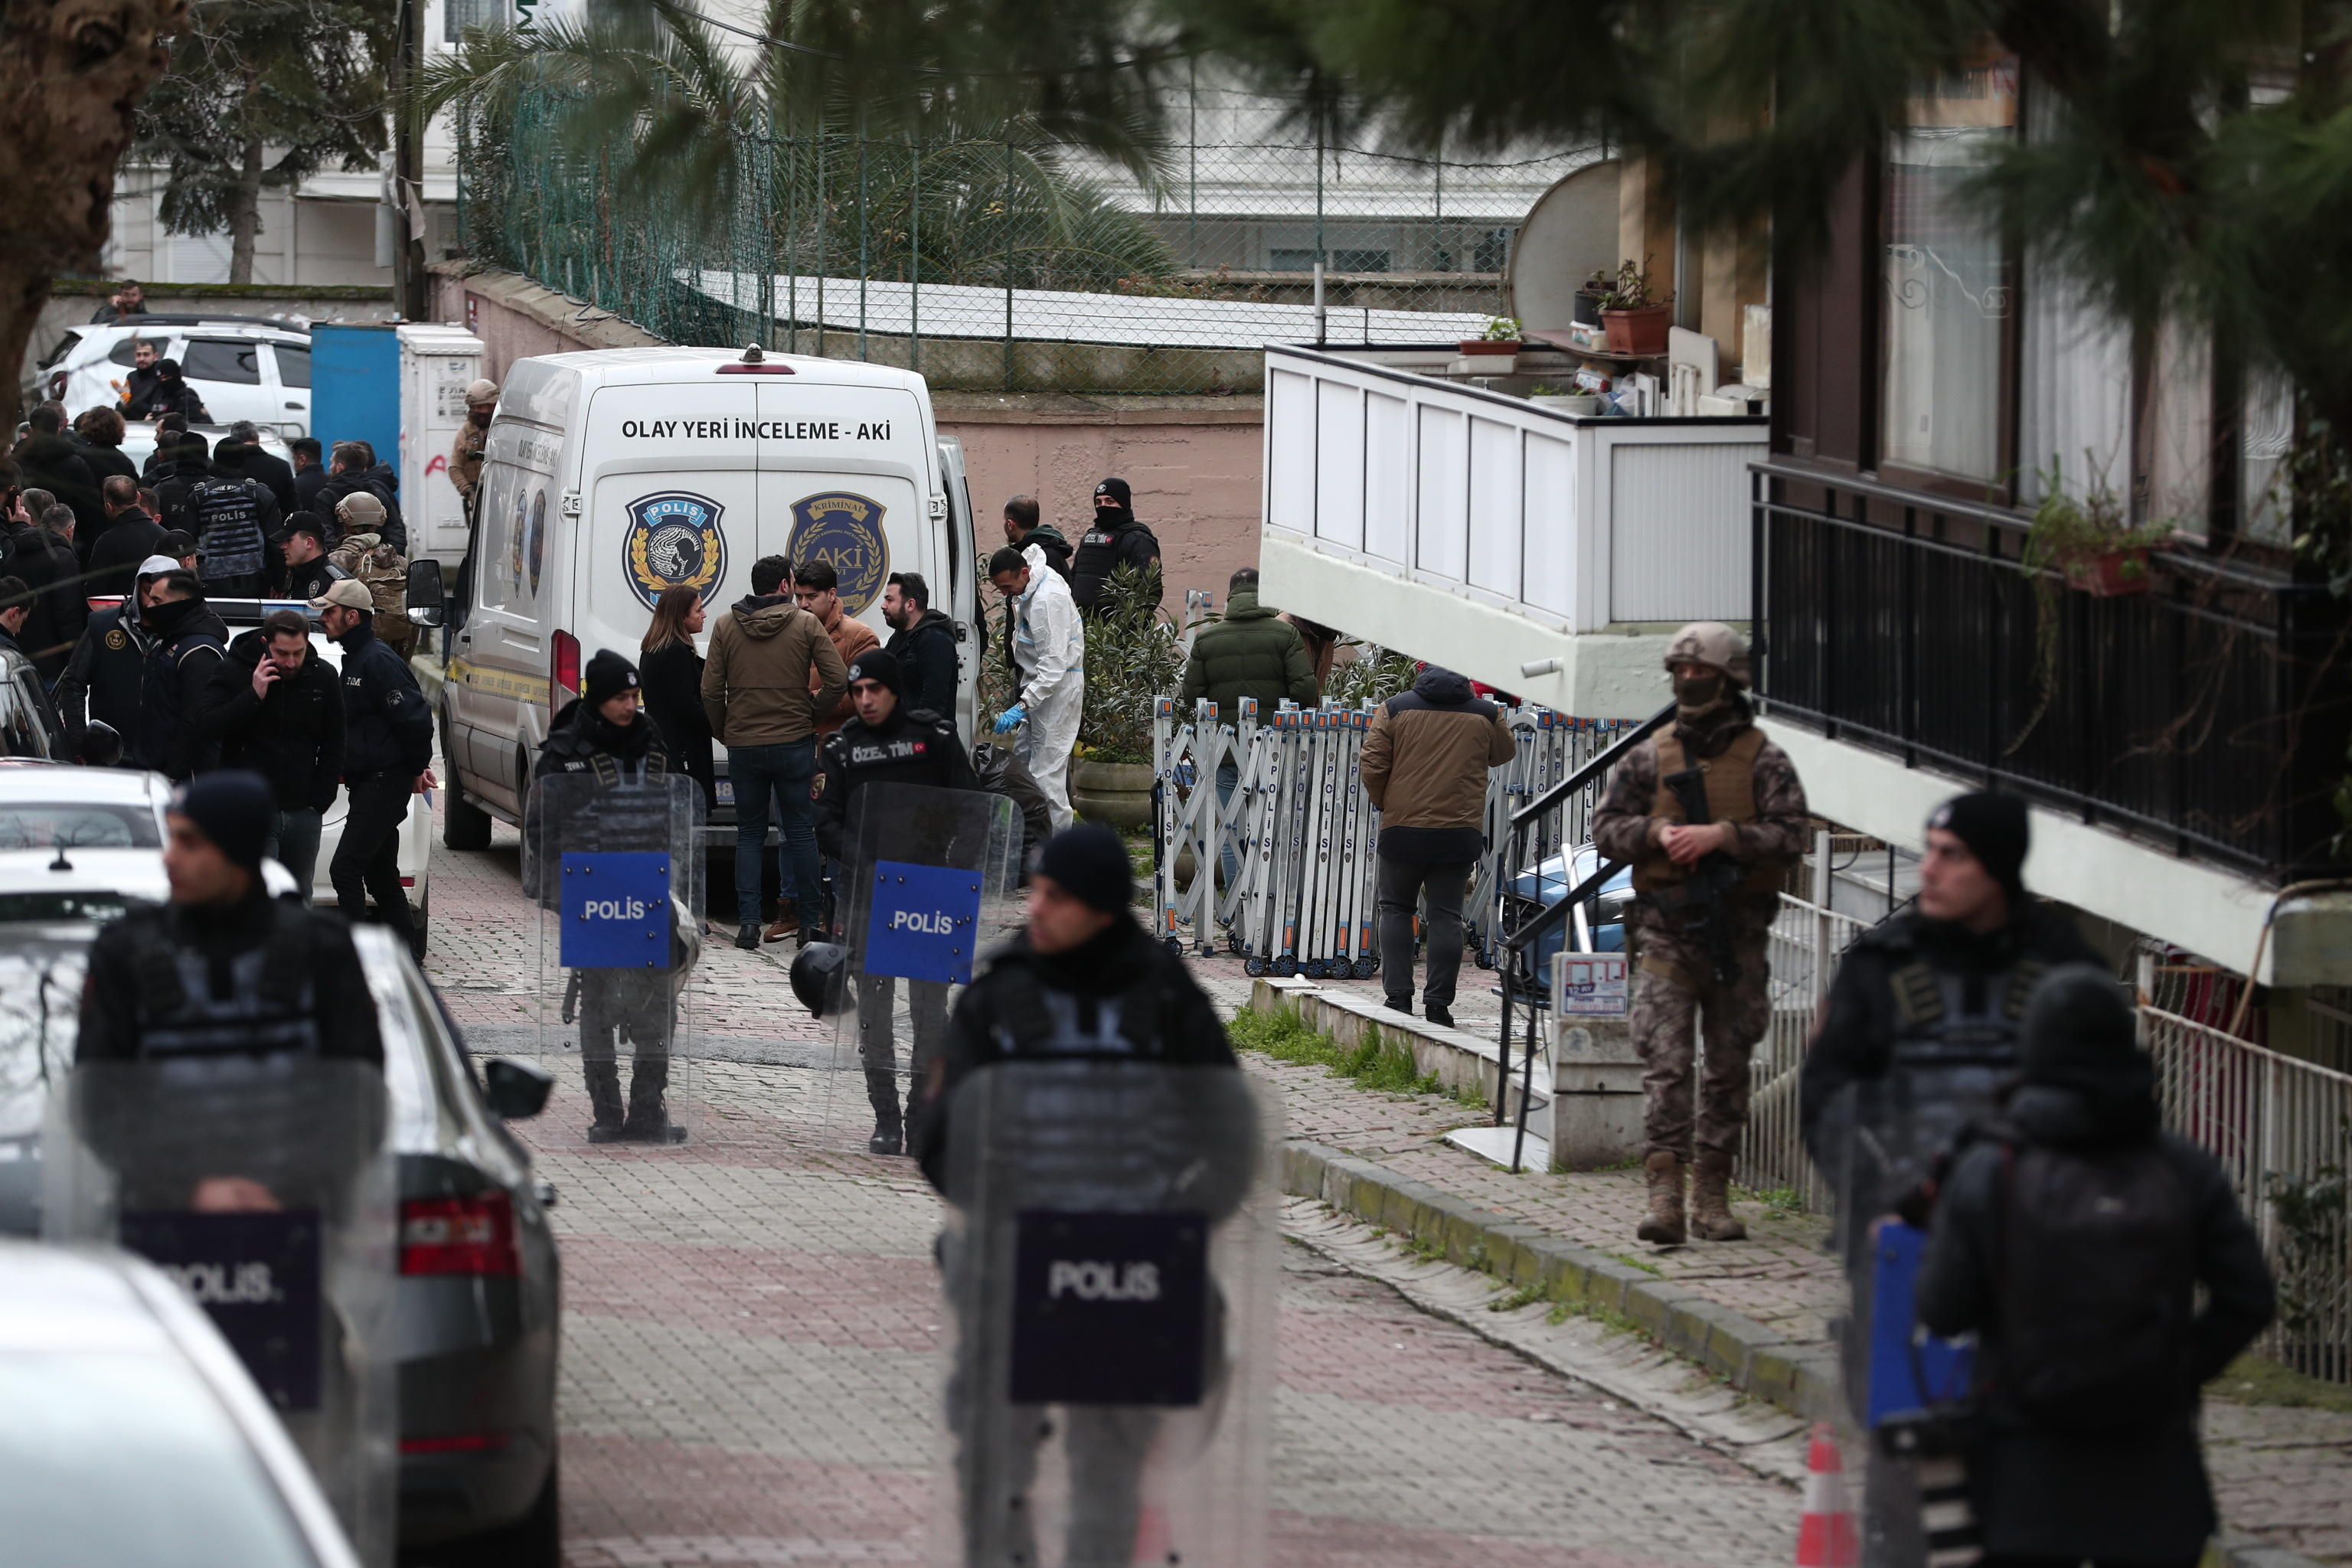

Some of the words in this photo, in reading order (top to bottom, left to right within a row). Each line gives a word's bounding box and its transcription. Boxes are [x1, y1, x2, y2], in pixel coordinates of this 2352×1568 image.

[622, 420, 678, 439] OLAY
[682, 417, 728, 439] YERİ
[735, 417, 839, 439] İNCELEME
[857, 420, 890, 440] AKİ
[211, 510, 247, 522] POLİS
[650, 502, 700, 517] POLİS
[814, 501, 864, 513] KRİMİNAL
[814, 544, 863, 567] AKİ
[852, 746, 887, 763] ÖZEL
[888, 740, 913, 757] TİM
[1164, 750, 1173, 832] POLİS
[1263, 766, 1278, 848] POLİS
[1321, 766, 1333, 848] POLİS
[1345, 766, 1357, 848] POLİS
[584, 896, 645, 920] POLİS
[893, 910, 953, 936] POLİS
[1048, 1260, 1161, 1301] POLİS
